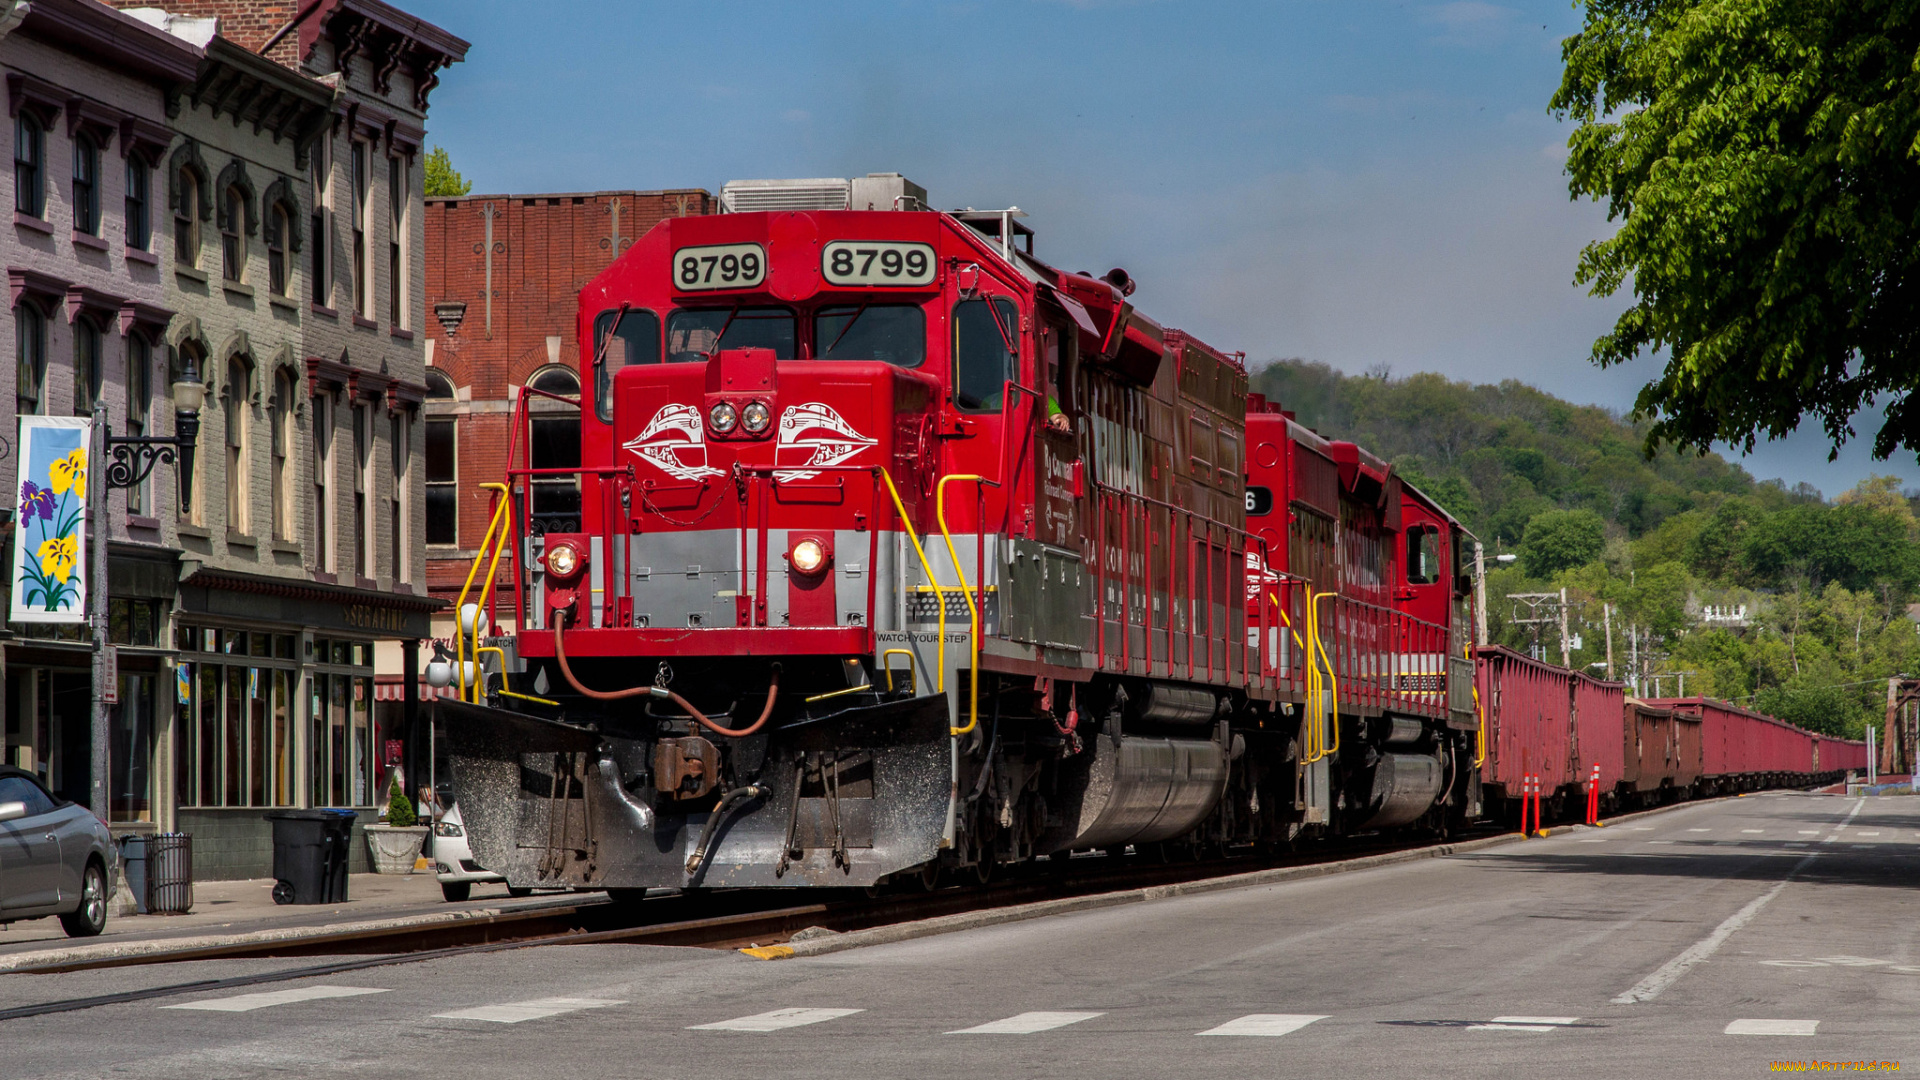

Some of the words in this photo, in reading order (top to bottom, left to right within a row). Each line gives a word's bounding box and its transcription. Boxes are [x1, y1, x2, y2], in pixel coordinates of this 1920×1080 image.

[681, 252, 760, 285] 8799
[830, 249, 928, 278] 8799
[1105, 545, 1145, 578] COMANY
[487, 639, 513, 648] WATCH
[877, 634, 911, 642] WATCH
[913, 634, 940, 643] YOUR
[943, 635, 967, 643] STEP
